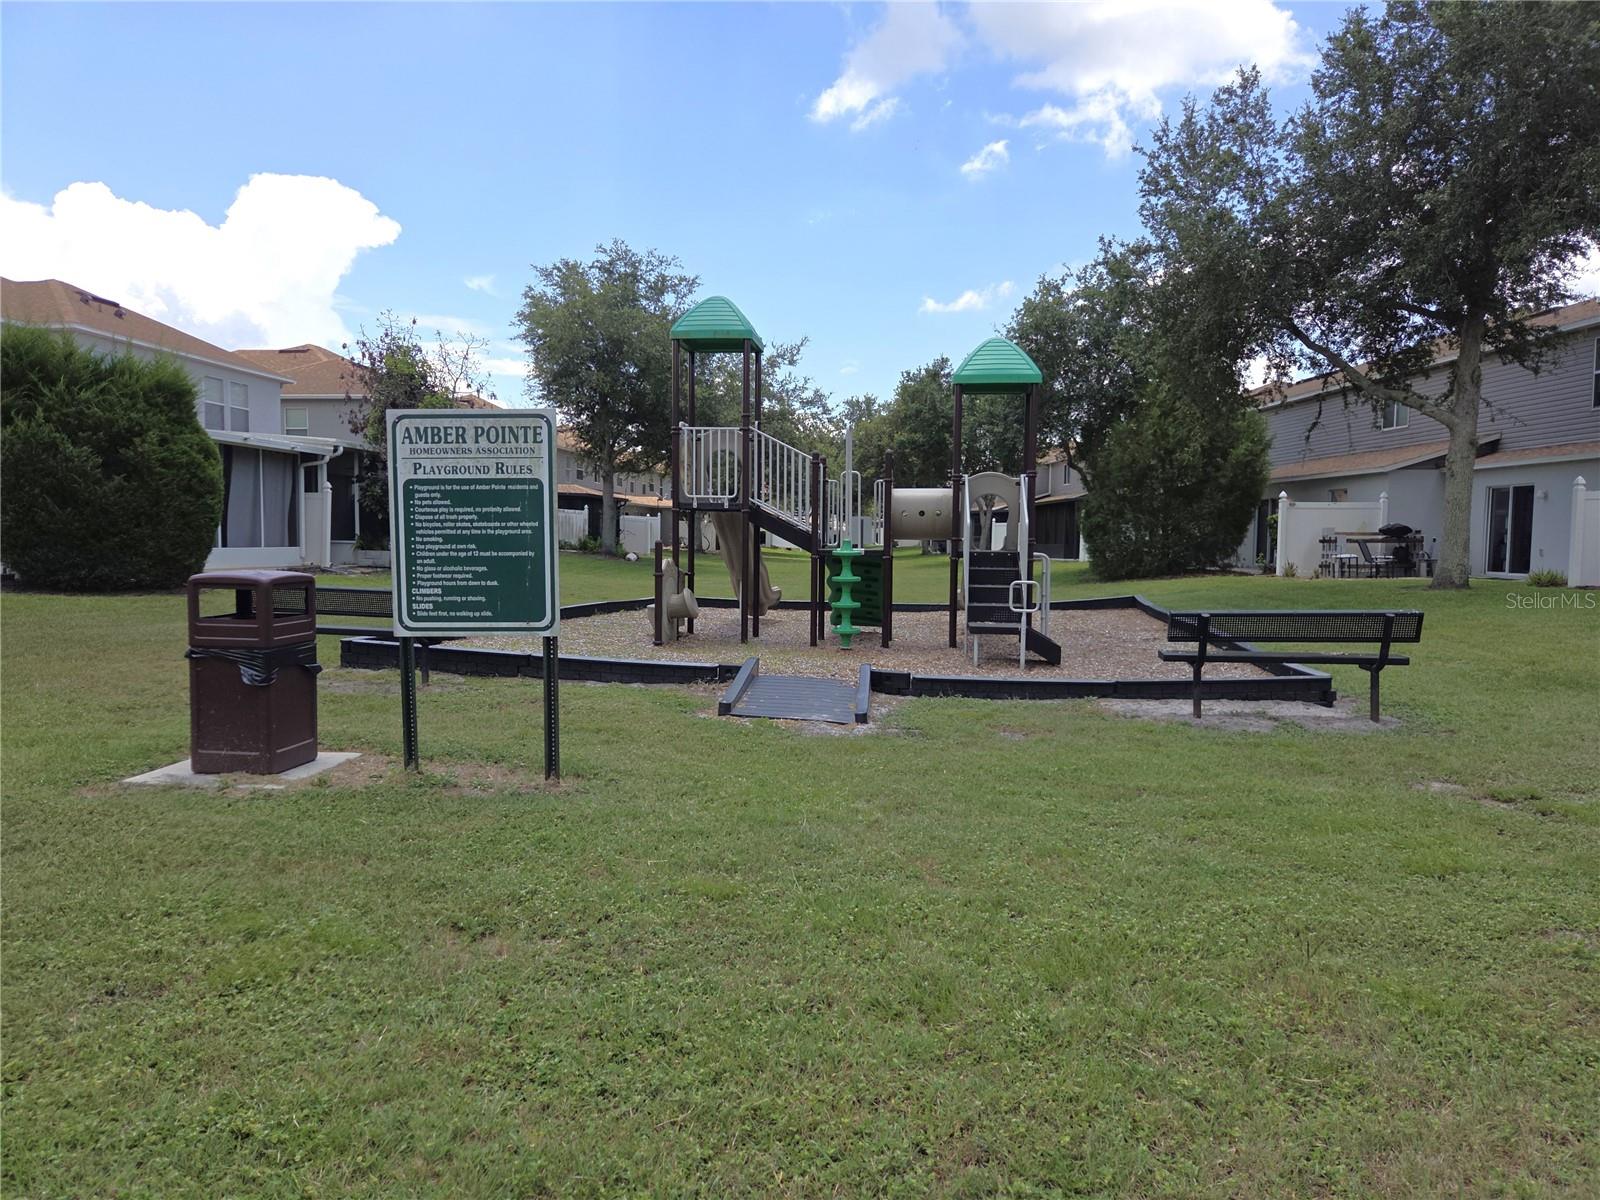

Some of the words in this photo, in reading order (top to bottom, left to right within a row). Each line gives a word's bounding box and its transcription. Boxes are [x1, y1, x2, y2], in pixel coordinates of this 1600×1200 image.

[401, 426, 467, 444] AMBER
[474, 426, 543, 444] POINTE
[410, 447, 472, 455] HOMEOWNERS
[476, 447, 536, 455] ASSOCIATION
[413, 462, 490, 474] PLAYGROUND
[496, 462, 533, 474] RULES
